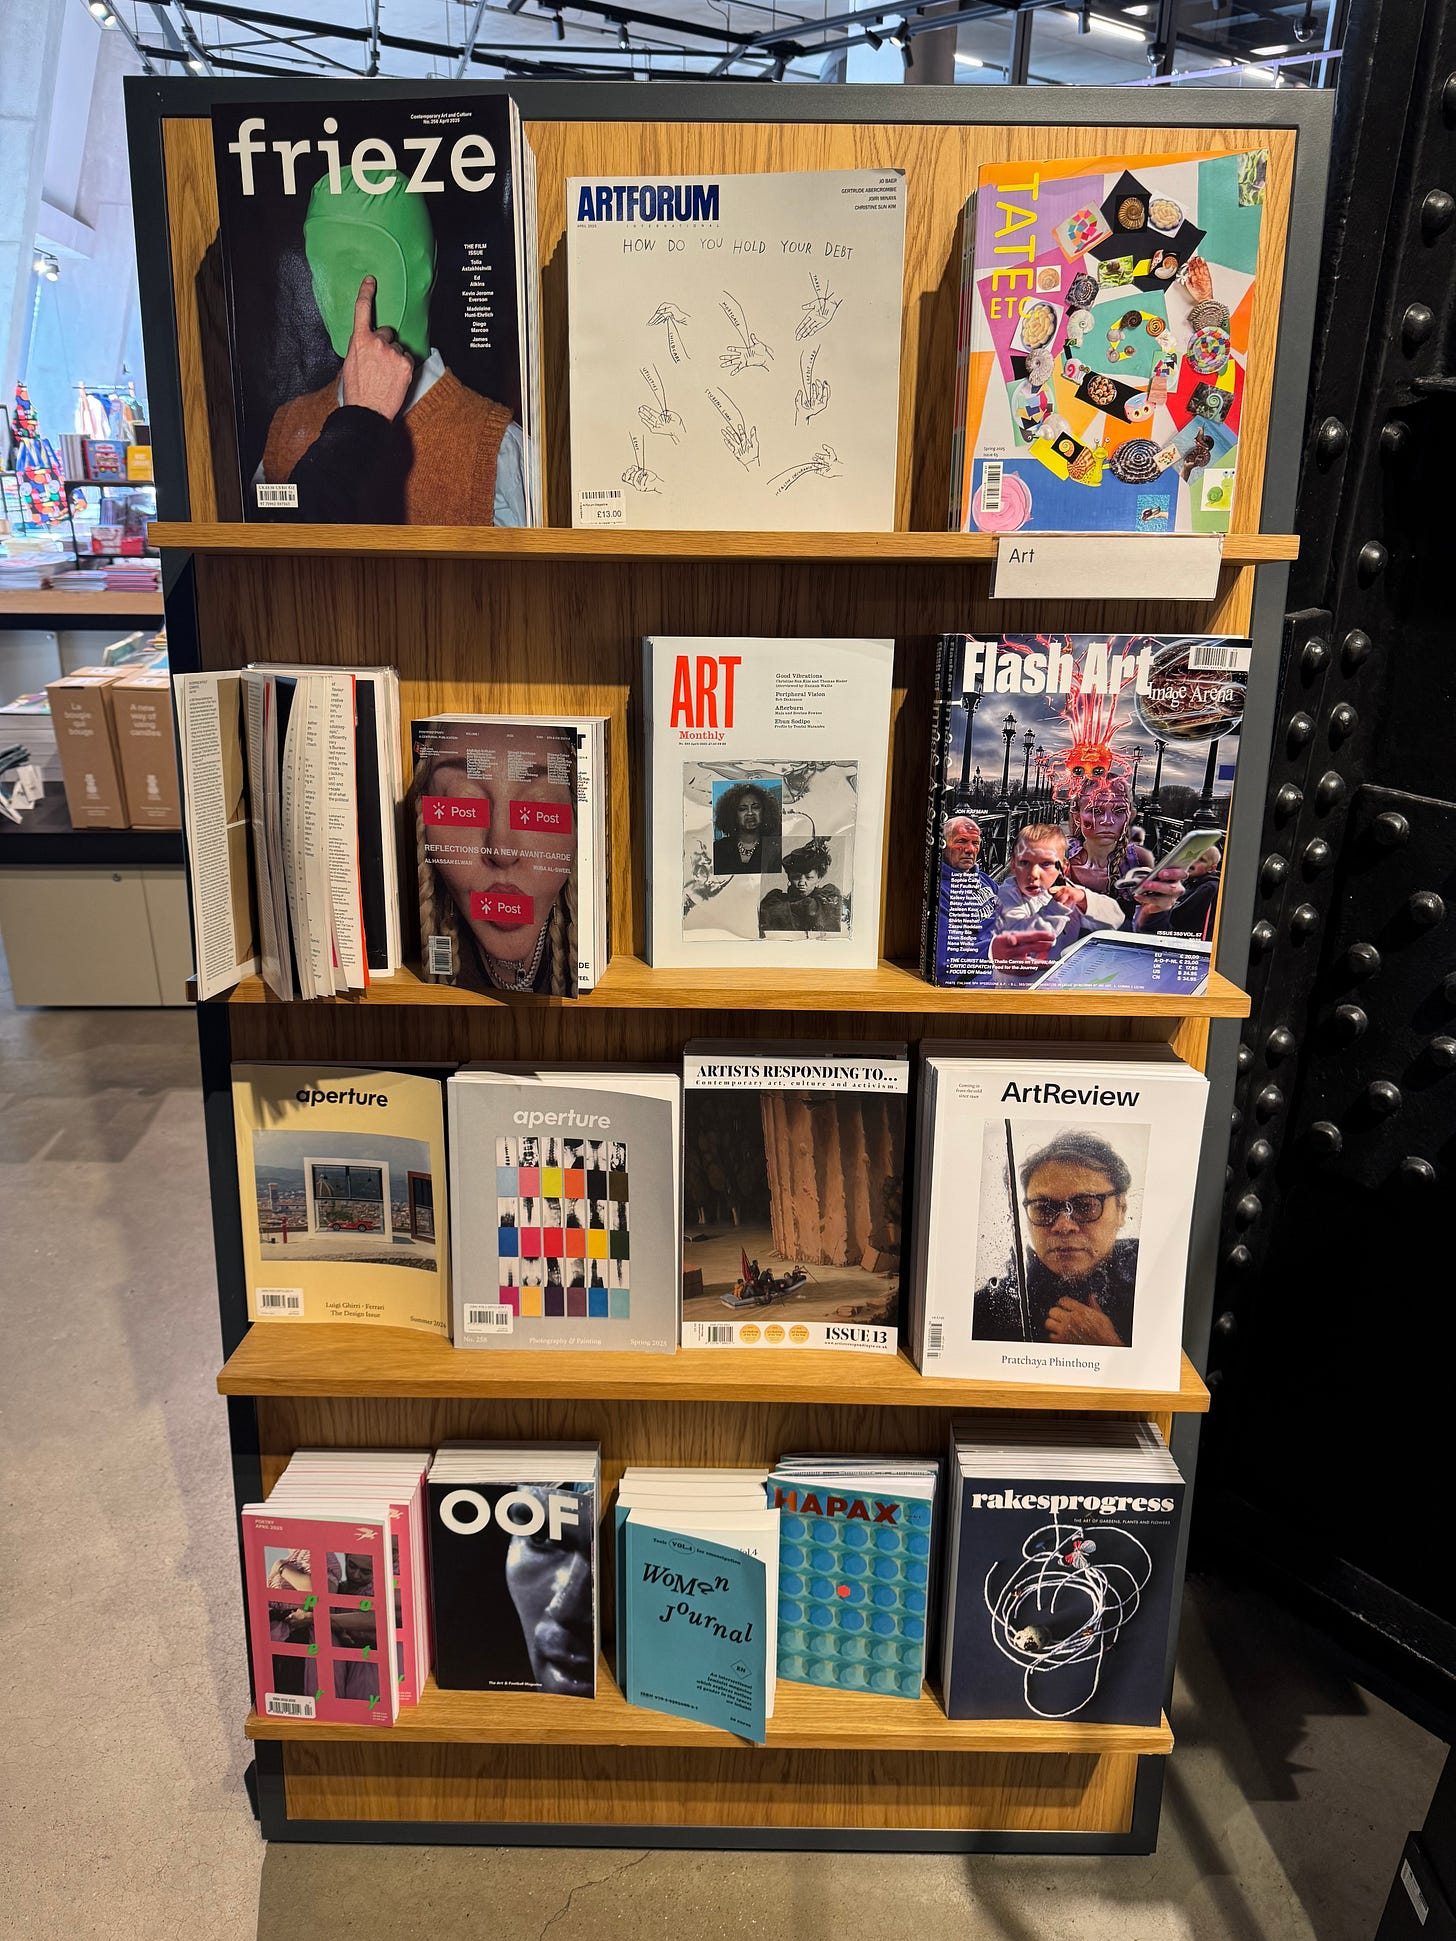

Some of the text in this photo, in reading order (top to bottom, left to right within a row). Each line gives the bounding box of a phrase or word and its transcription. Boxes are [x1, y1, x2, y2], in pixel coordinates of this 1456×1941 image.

[228, 117, 496, 195] frieze
[577, 184, 720, 221] ARTFORUM
[991, 172, 1040, 292] TATE
[623, 237, 853, 260] HOW DO YOU HOLD YOUR DEBT
[990, 296, 1040, 319] ETC.
[597, 510, 622, 518] £13.00
[1008, 548, 1035, 564] Art
[962, 641, 1153, 695] Flash Art
[670, 655, 742, 728] ART
[1148, 681, 1234, 707] Image Arena
[64, 711, 92, 719] bougie
[71, 703, 82, 711] La
[131, 713, 146, 721] way
[133, 721, 156, 729] using
[68, 728, 94, 736] bouge
[129, 729, 162, 737] candles
[678, 730, 725, 741] Monthly
[451, 806, 477, 818] Post
[536, 812, 560, 824] Post
[424, 844, 479, 854] REFLECTIONS
[480, 847, 492, 855] ON
[500, 848, 518, 857] NEW
[519, 850, 571, 862] AVANT-GARDE
[497, 902, 522, 915] Post
[696, 1064, 898, 1082] ARTISTS RESPONDING TO...
[695, 1079, 763, 1087] Contemporary
[790, 1079, 827, 1087] culture
[295, 1087, 389, 1108] aperture
[1000, 1081, 1140, 1107] ArtReview
[513, 1109, 611, 1129] aperture
[325, 1301, 341, 1310] Luigi
[365, 1303, 385, 1311] Ferrari
[343, 1310, 365, 1318] Design
[410, 1315, 433, 1326] Summer
[529, 1337, 602, 1346] Photography & Painting
[630, 1338, 667, 1347] Spring 2025
[825, 1327, 887, 1344] ISSUE 13
[1001, 1355, 1101, 1372] Pratchaya Phinthong
[774, 1487, 900, 1525] HAPAX
[971, 1489, 1175, 1516] rakesprogress
[439, 1489, 579, 1541] OOF
